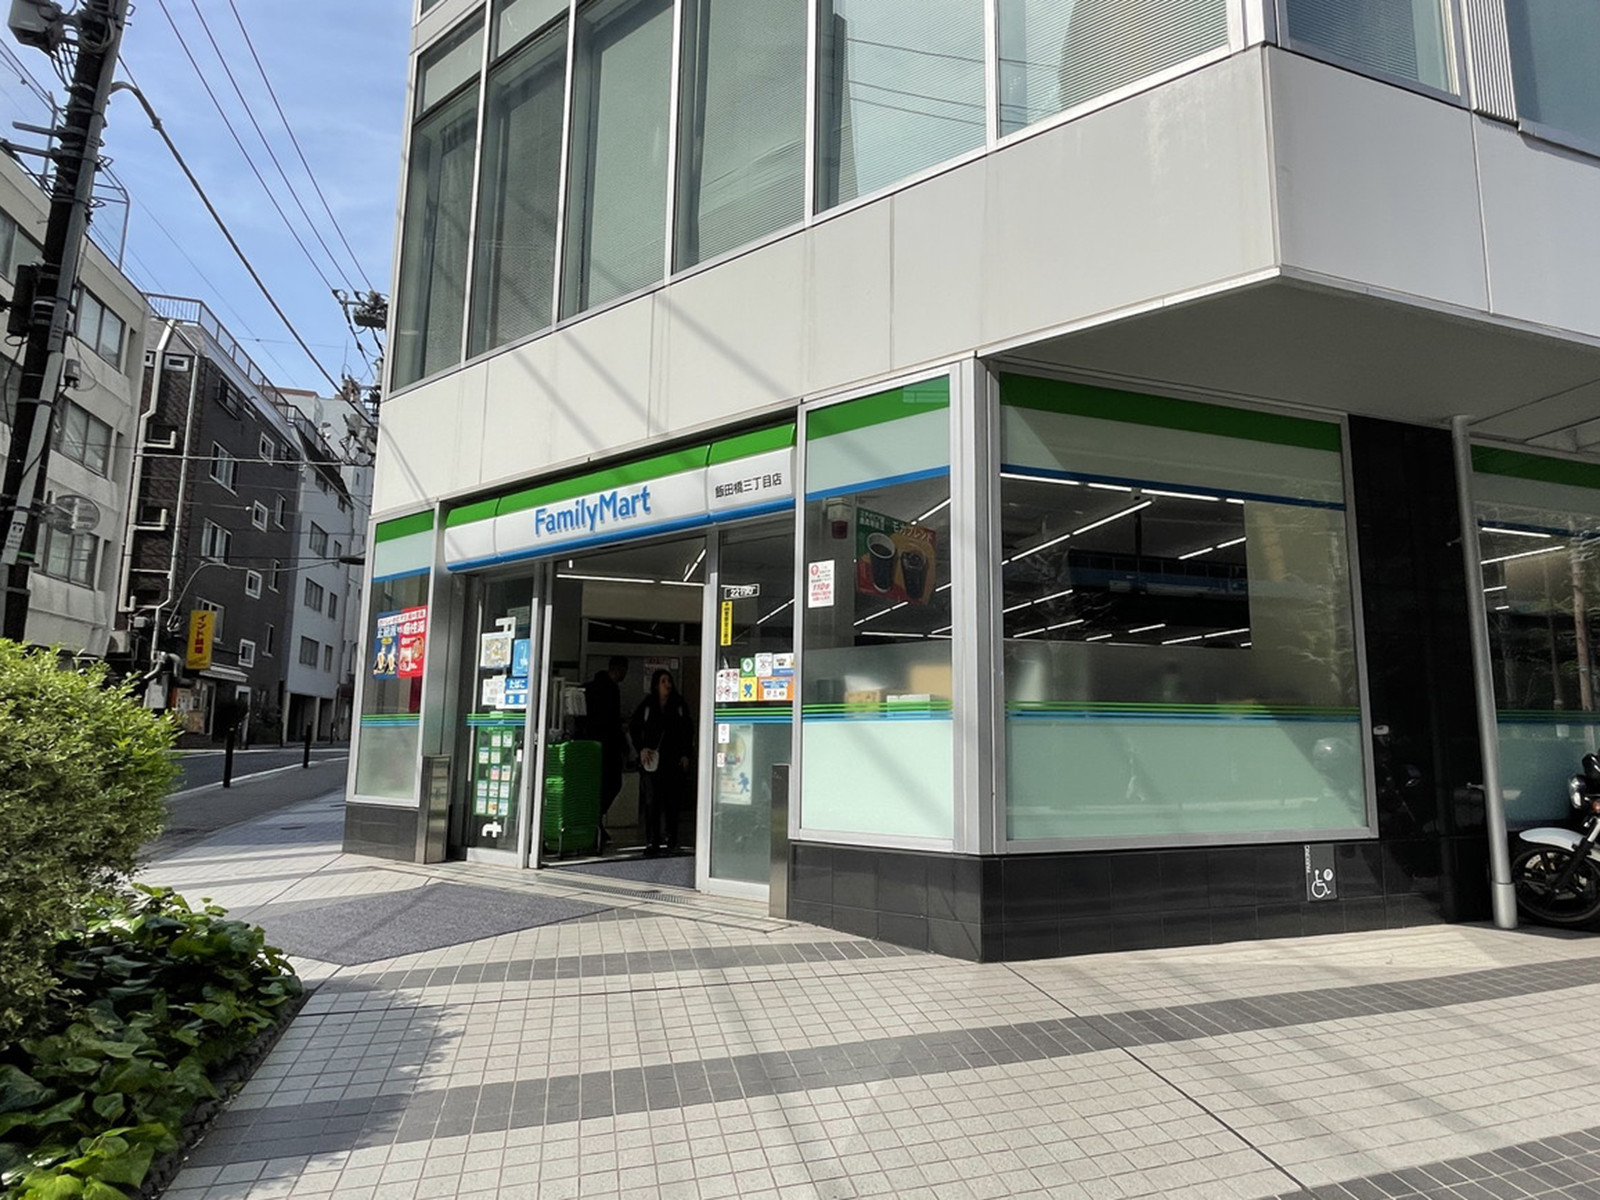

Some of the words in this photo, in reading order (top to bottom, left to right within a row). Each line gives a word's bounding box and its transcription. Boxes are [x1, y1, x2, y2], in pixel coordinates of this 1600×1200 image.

[715, 472, 783, 499] 飯田橋三丁目店
[534, 485, 652, 536] FamilyMart
